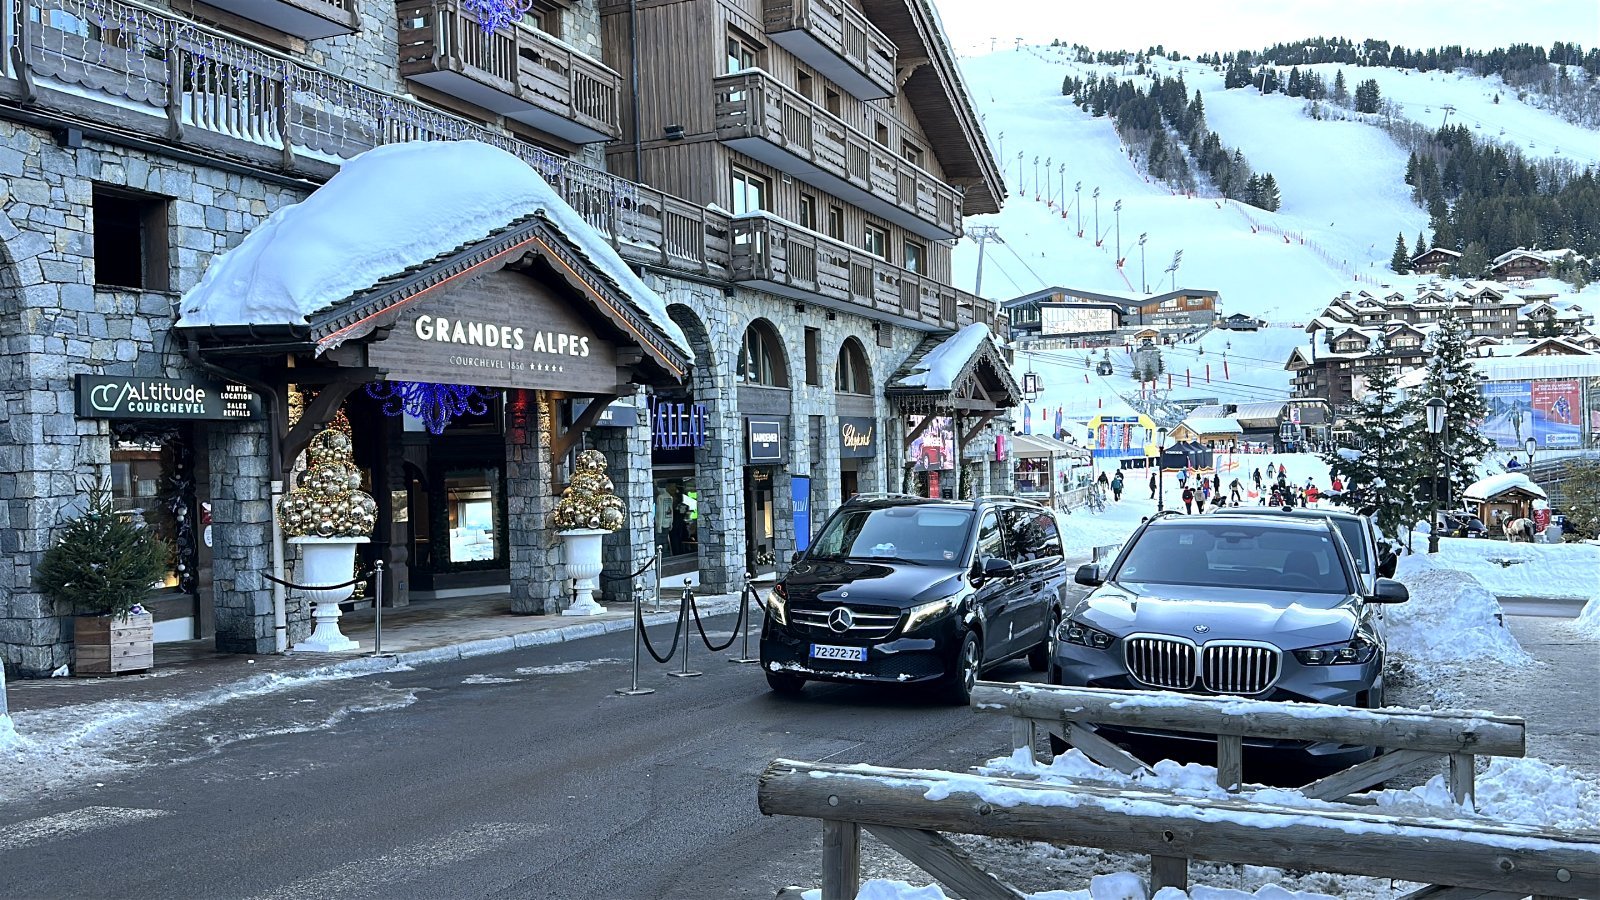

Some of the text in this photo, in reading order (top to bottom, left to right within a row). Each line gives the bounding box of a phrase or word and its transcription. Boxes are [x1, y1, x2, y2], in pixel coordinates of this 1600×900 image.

[415, 314, 590, 358] GRANDES ALPES
[449, 355, 525, 371] COURCHEVEL 1850
[220, 392, 253, 400] LOCATION
[127, 402, 206, 414] COURCHEVEL
[226, 402, 247, 410] SALES
[223, 409, 251, 417] RENTALS
[842, 423, 872, 452] Chopard
